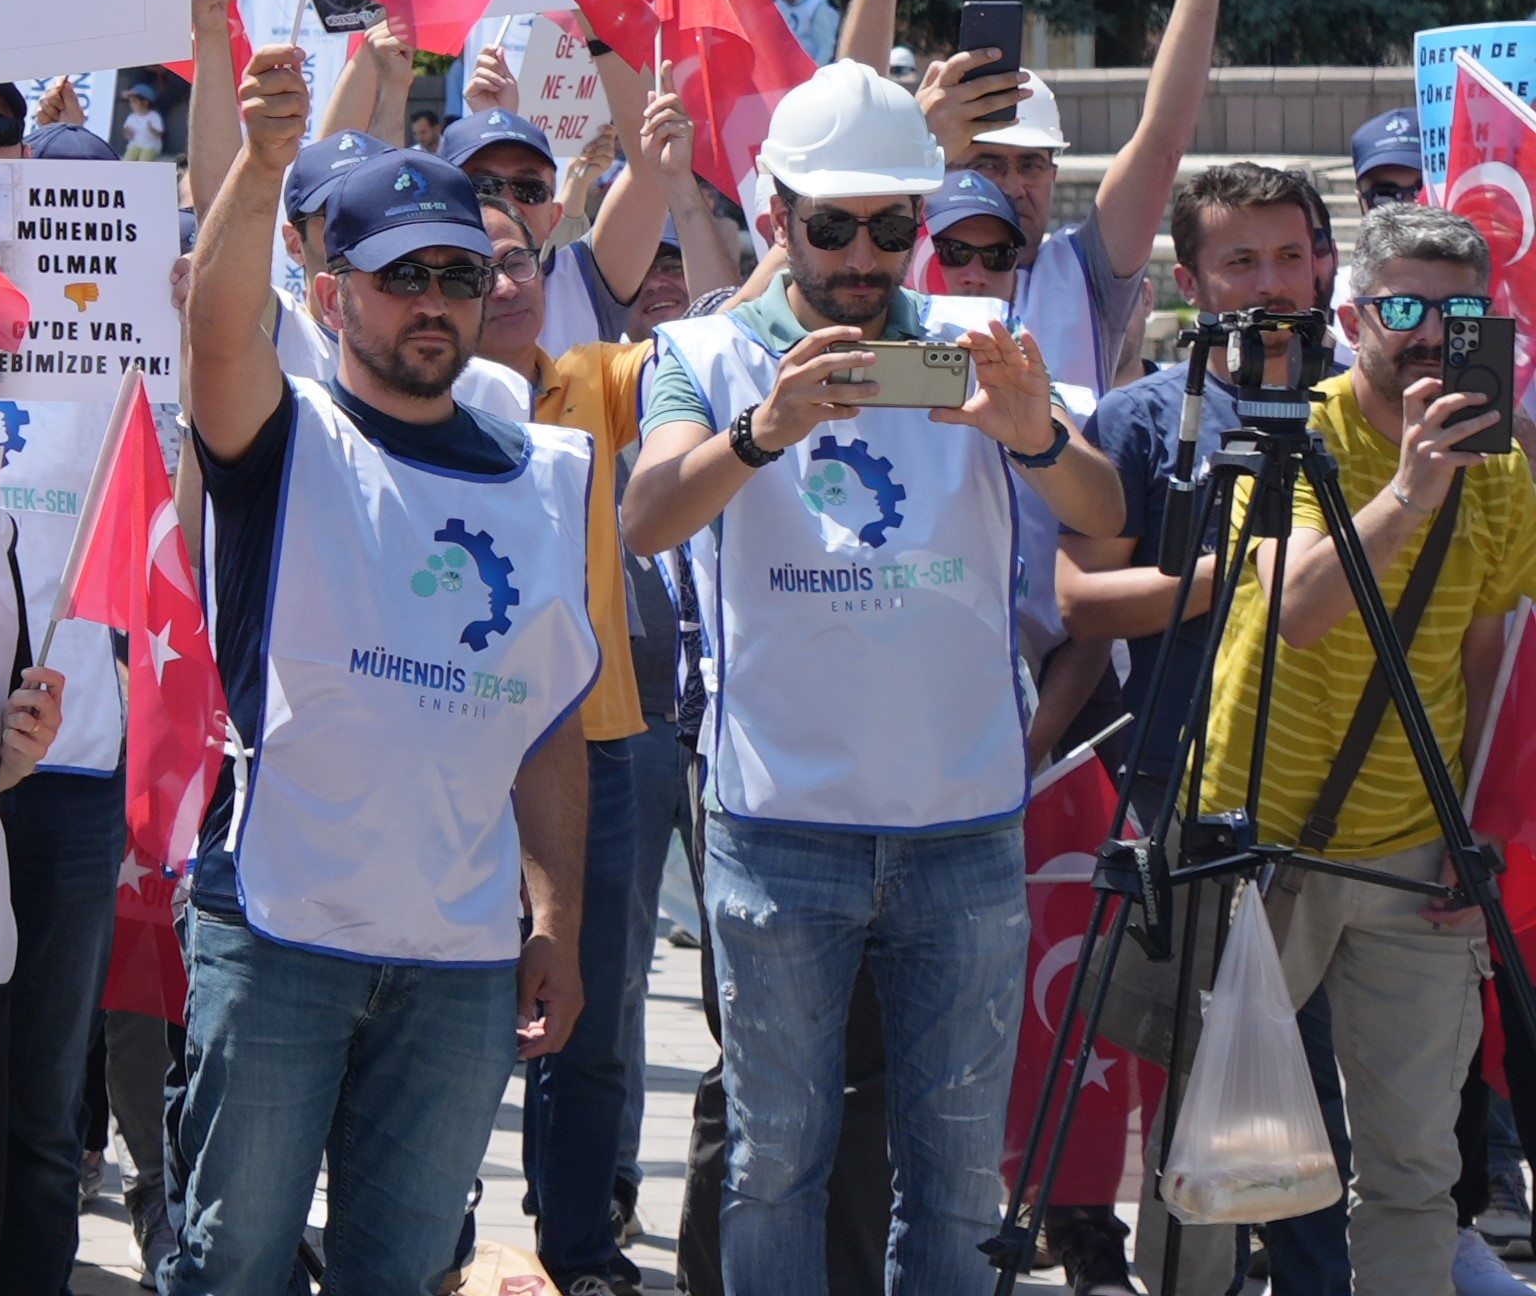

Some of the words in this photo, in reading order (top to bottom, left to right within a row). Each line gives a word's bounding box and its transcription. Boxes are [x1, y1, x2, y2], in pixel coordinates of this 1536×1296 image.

[1491, 42, 1518, 58] DE
[555, 115, 589, 140] RUZ
[28, 187, 126, 209] KAMUDA
[17, 218, 138, 242] MÜHENDİS
[37, 253, 118, 275] OLMAK
[11, 319, 79, 341] CV'DE
[89, 322, 143, 344] VAR,
[0, 486, 77, 515] TEK-SEN
[769, 562, 874, 593] MÜHENDİS
[879, 558, 964, 590] TEK-SEN
[831, 594, 904, 612] ENERJİ
[349, 646, 466, 693] MÜHENDİS
